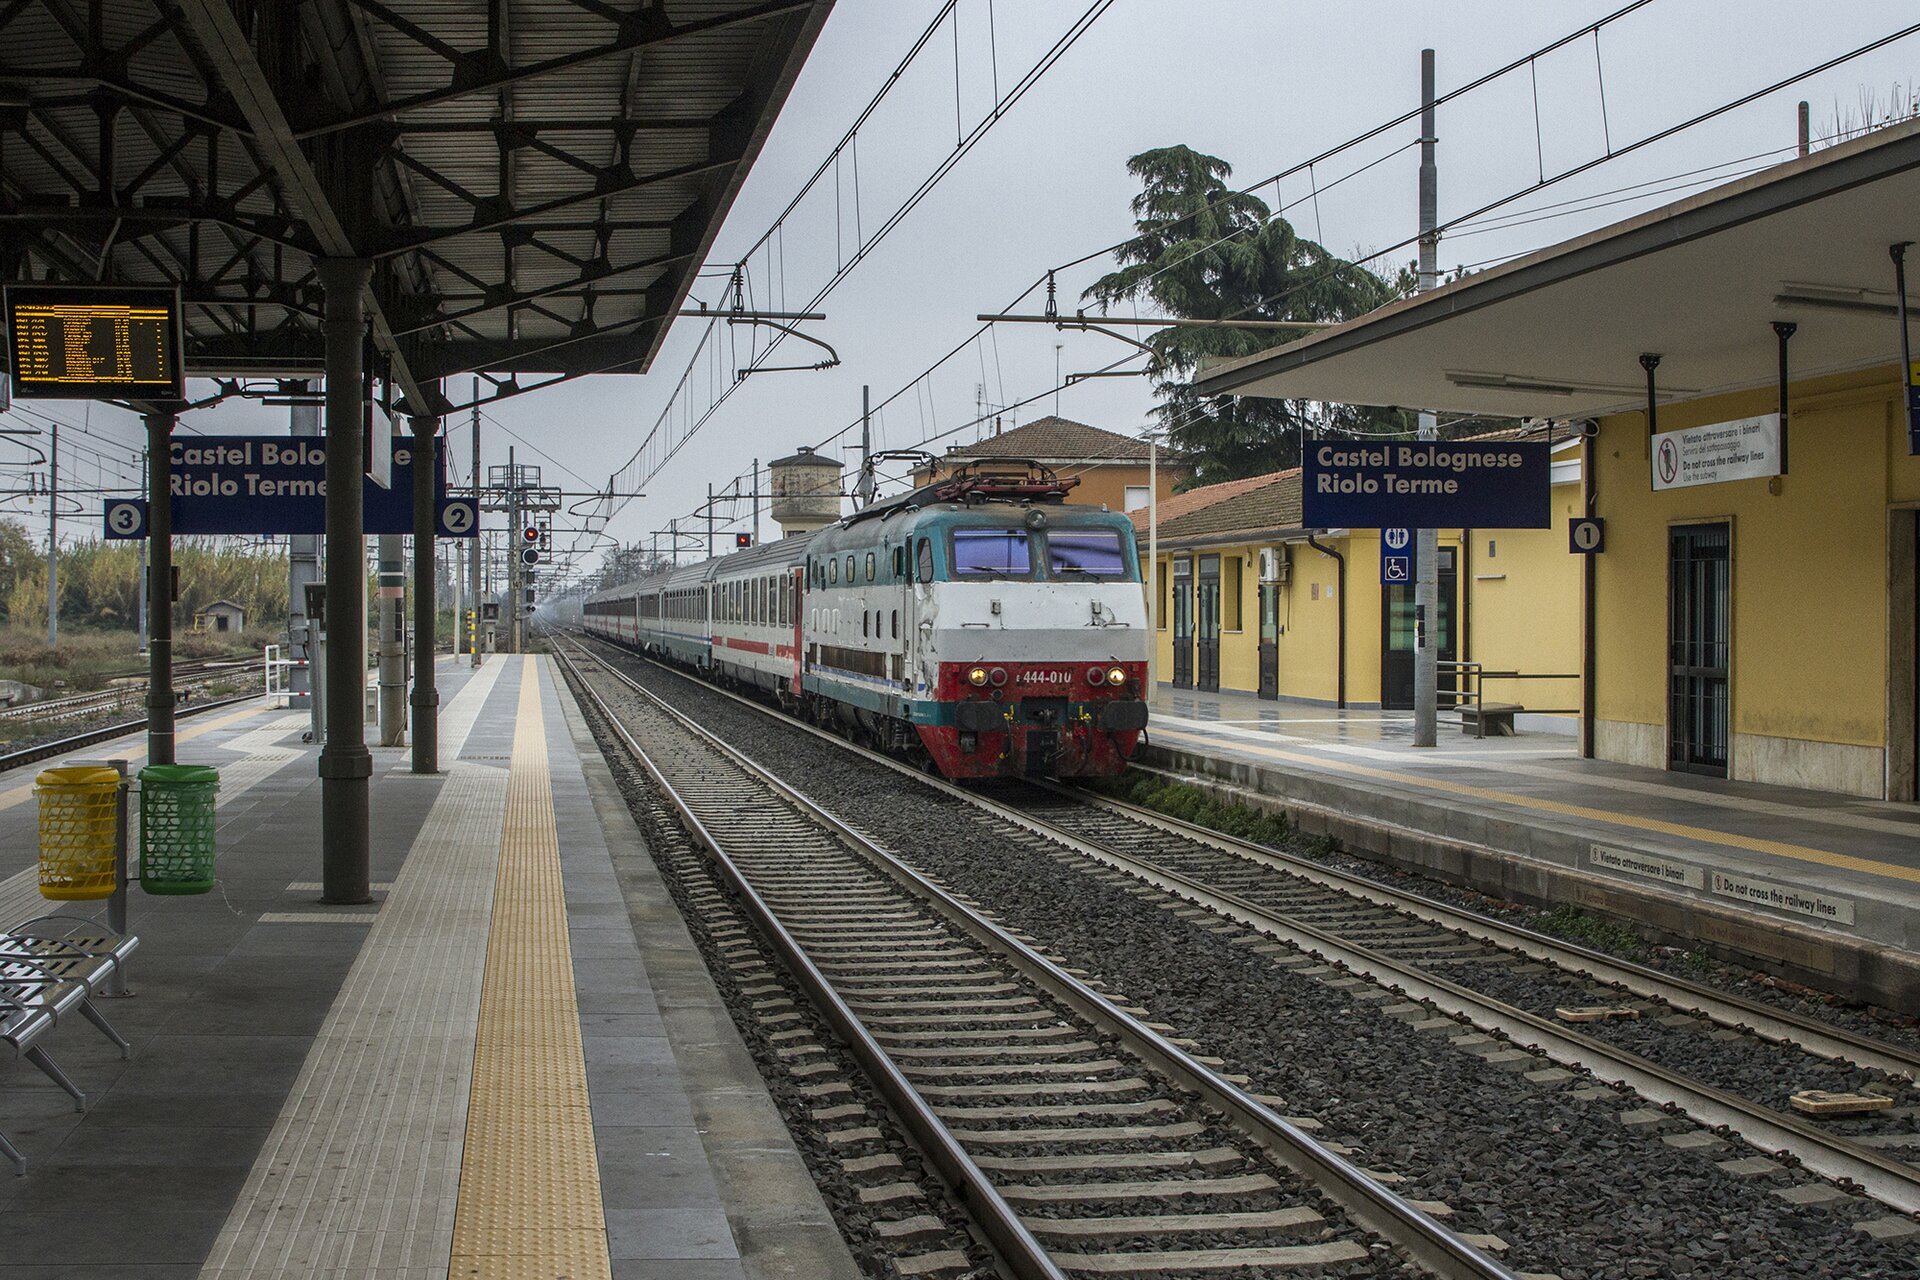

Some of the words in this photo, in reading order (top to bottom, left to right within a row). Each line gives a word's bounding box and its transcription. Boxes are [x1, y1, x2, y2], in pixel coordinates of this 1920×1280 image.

[1682, 433, 1701, 445] Vietato
[1703, 428, 1738, 441] attraversare
[1743, 423, 1760, 435] binari
[170, 442, 252, 465] Castel
[1317, 446, 1390, 468] Castel
[1398, 446, 1523, 472] Bolognese
[1683, 461, 1690, 471] Do
[1692, 460, 1701, 469] not
[1702, 459, 1716, 468] cross
[1716, 456, 1726, 465] the
[1727, 453, 1749, 465] railway
[1750, 451, 1764, 461] lines
[170, 472, 239, 497] Riolo
[1317, 473, 1378, 494] Riolo
[1384, 473, 1459, 495] Terme
[117, 509, 134, 529] 3
[450, 508, 467, 528] 2
[1583, 527, 1592, 545] 1
[1023, 671, 1072, 683] 444-010
[1600, 850, 1621, 867] Vietato
[1622, 857, 1660, 876] attraversare
[1665, 865, 1685, 881] binari
[1723, 878, 1734, 892] Do
[1735, 883, 1748, 895] not
[1749, 888, 1769, 901] cross
[1770, 889, 1783, 904] the
[1785, 894, 1815, 913] railway
[1816, 899, 1837, 916] lines
